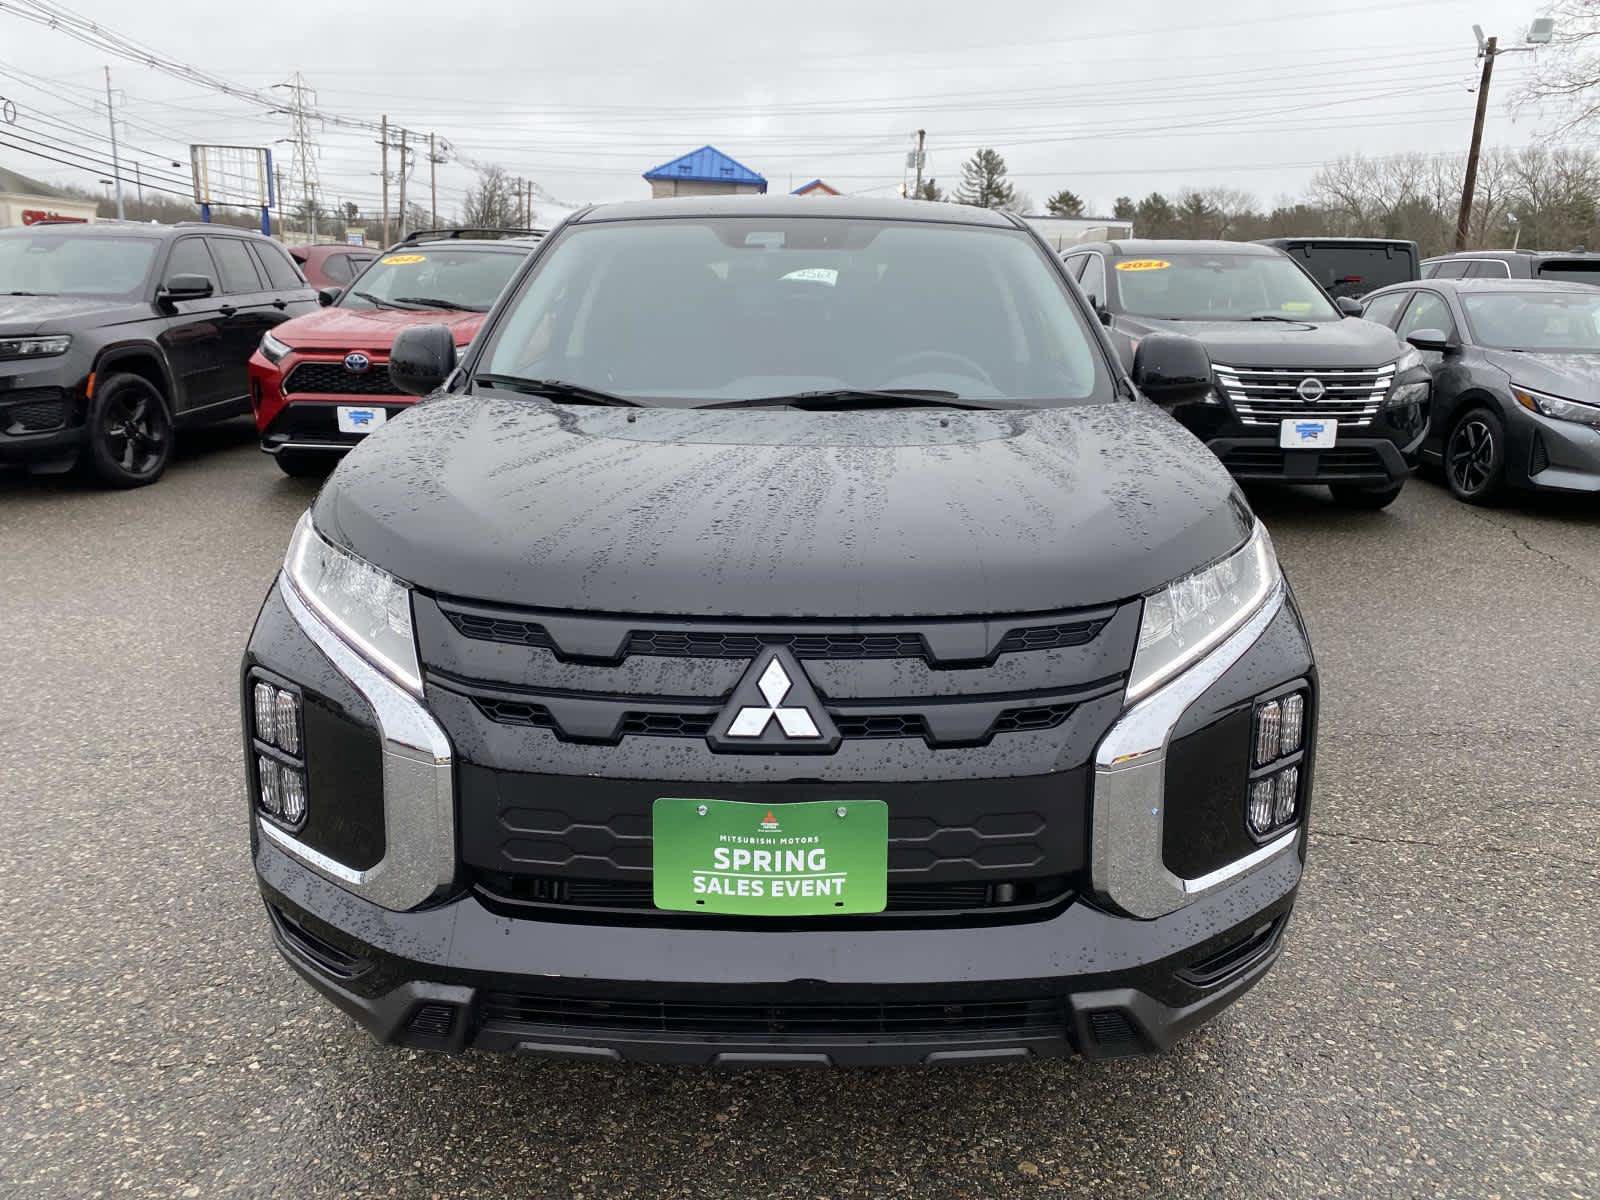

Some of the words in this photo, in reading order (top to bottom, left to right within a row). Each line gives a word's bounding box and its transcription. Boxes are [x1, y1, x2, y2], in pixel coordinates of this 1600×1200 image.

[1121, 261, 1165, 270] 2024
[719, 834, 776, 845] MITSUBISHI
[780, 835, 820, 844] MOTORS
[713, 847, 827, 872] SPRING
[692, 876, 765, 897] SALES
[771, 877, 846, 897] EVENT
